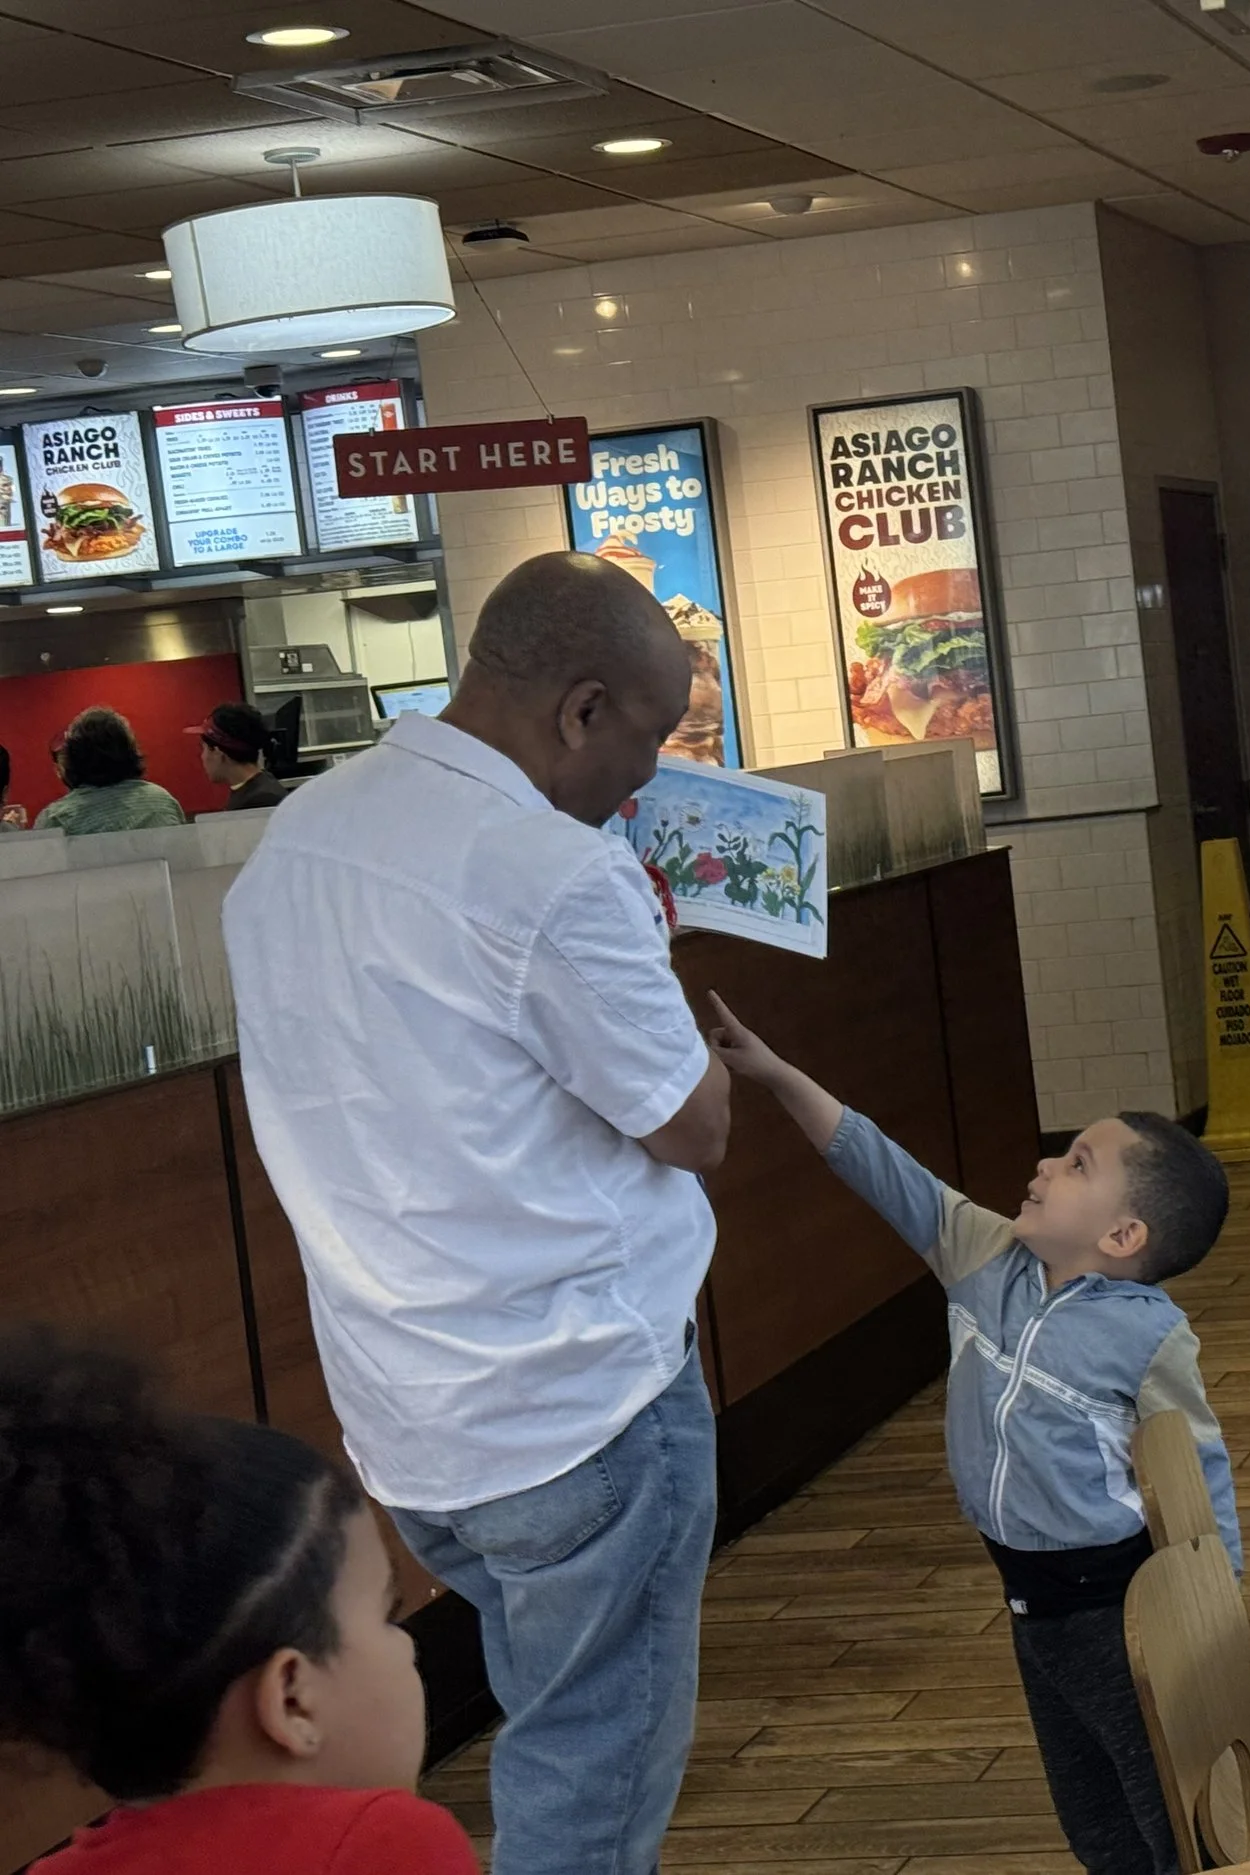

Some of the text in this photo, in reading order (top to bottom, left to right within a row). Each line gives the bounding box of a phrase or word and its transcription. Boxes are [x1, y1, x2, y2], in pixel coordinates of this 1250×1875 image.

[325, 390, 358, 404] DRINKS
[174, 411, 205, 423] SIDES
[215, 407, 261, 419] SWEETS
[42, 426, 116, 449] ASIAGO
[830, 423, 957, 461] ASIAGO
[43, 442, 119, 466] RANCH
[348, 446, 461, 478] START
[479, 438, 577, 470] HERE
[592, 444, 680, 479] Fresh
[45, 460, 121, 476] CHICKEN CLUB
[831, 449, 961, 488] RANCH
[576, 475, 702, 512] Ways to
[835, 479, 962, 512] CHICKEN
[591, 506, 696, 538] Frosty
[838, 504, 966, 551] CLUB
[188, 534, 248, 547] YOUR COMBO
[195, 528, 237, 538] UPGRADE
[193, 546, 205, 554] TO
[215, 542, 245, 552] LARGE
[859, 585, 883, 595] MAKE
[867, 593, 877, 602] IT
[860, 600, 886, 613] SPICY
[1212, 961, 1248, 975] CAUTION
[1223, 975, 1239, 987] WET
[1220, 988, 1245, 1002] FLOOR
[1226, 1019, 1245, 1032] PISO
